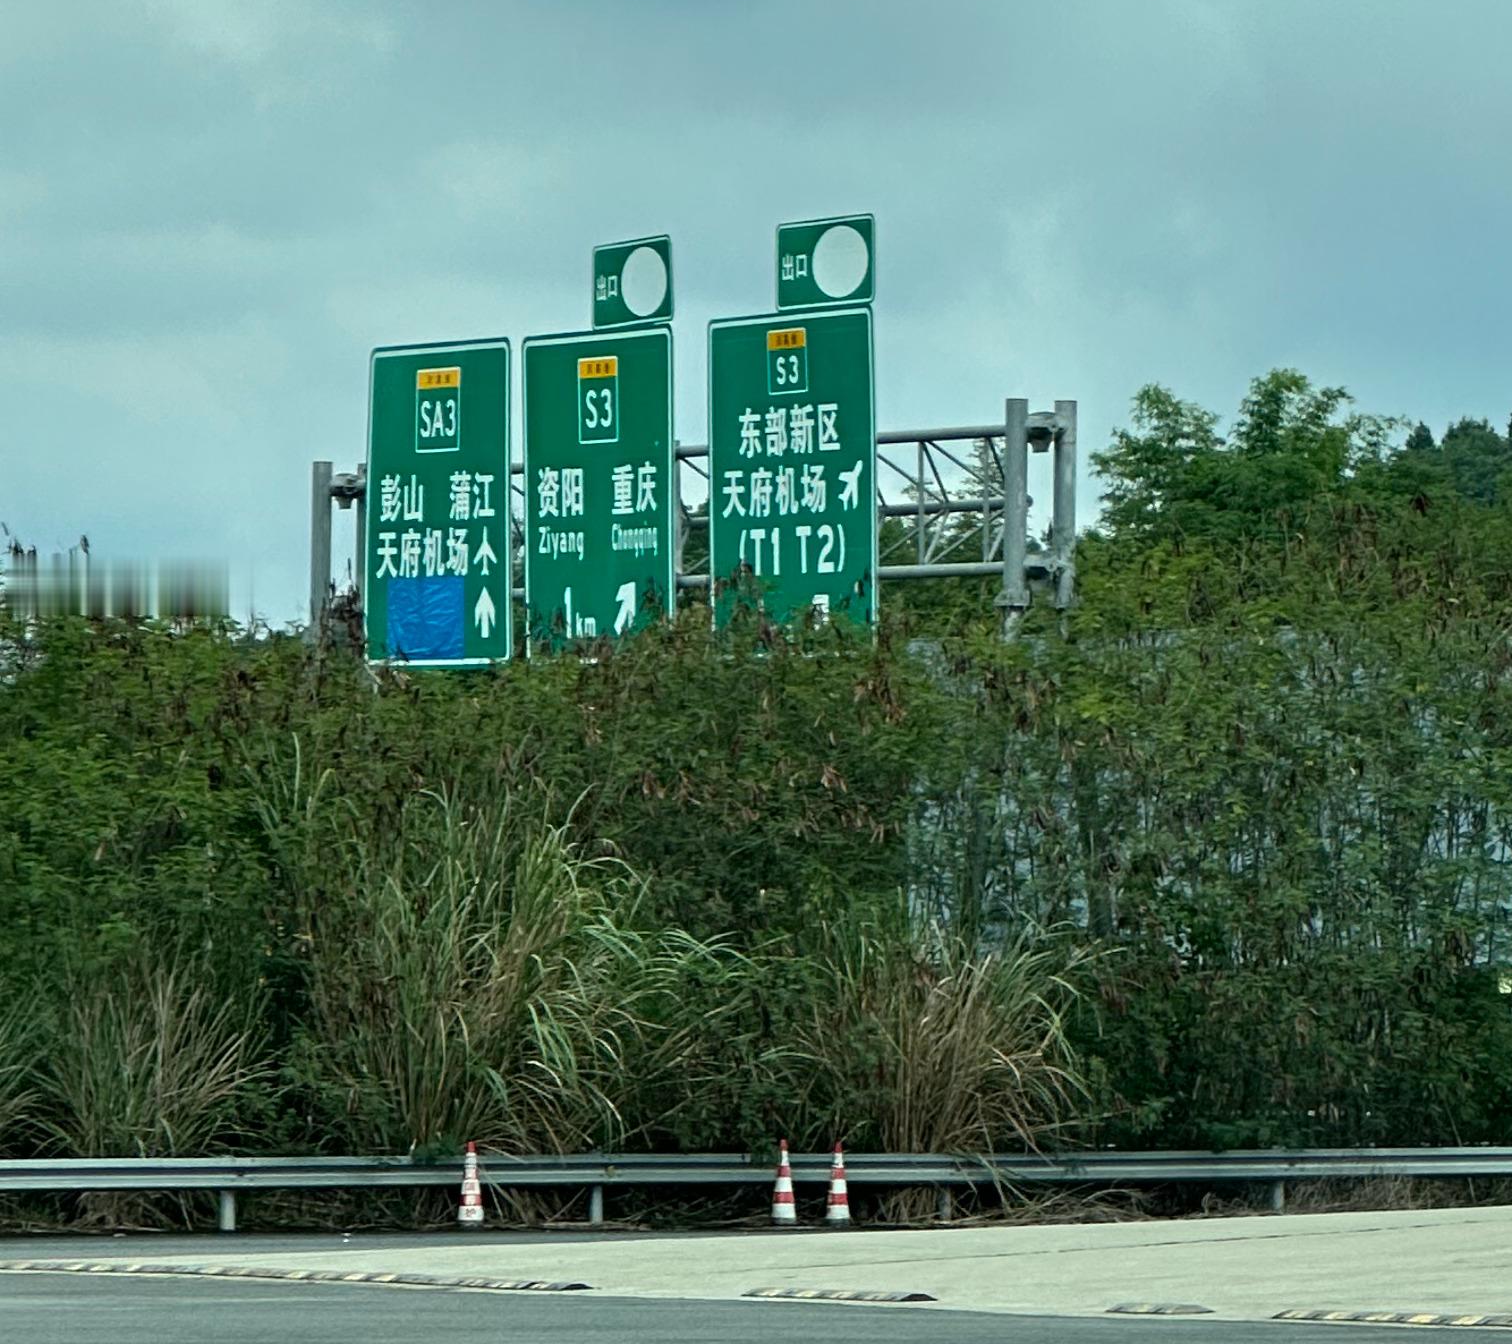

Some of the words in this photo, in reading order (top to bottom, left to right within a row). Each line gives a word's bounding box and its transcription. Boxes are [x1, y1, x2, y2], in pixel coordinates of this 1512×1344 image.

[596, 274, 618, 301] 出口
[781, 253, 808, 281] 出口
[776, 355, 799, 385] S3
[419, 399, 457, 438] SA3
[585, 388, 613, 429] S3
[738, 403, 841, 458] 东部新区
[379, 473, 424, 523] 彭山
[449, 469, 496, 521] 蒲江
[537, 466, 584, 518] 资阳
[611, 460, 658, 515] 重庆
[721, 463, 827, 519] 天府机场
[375, 526, 470, 579] 天府机场
[538, 526, 584, 560] Ziyang
[795, 523, 846, 574] T2)
